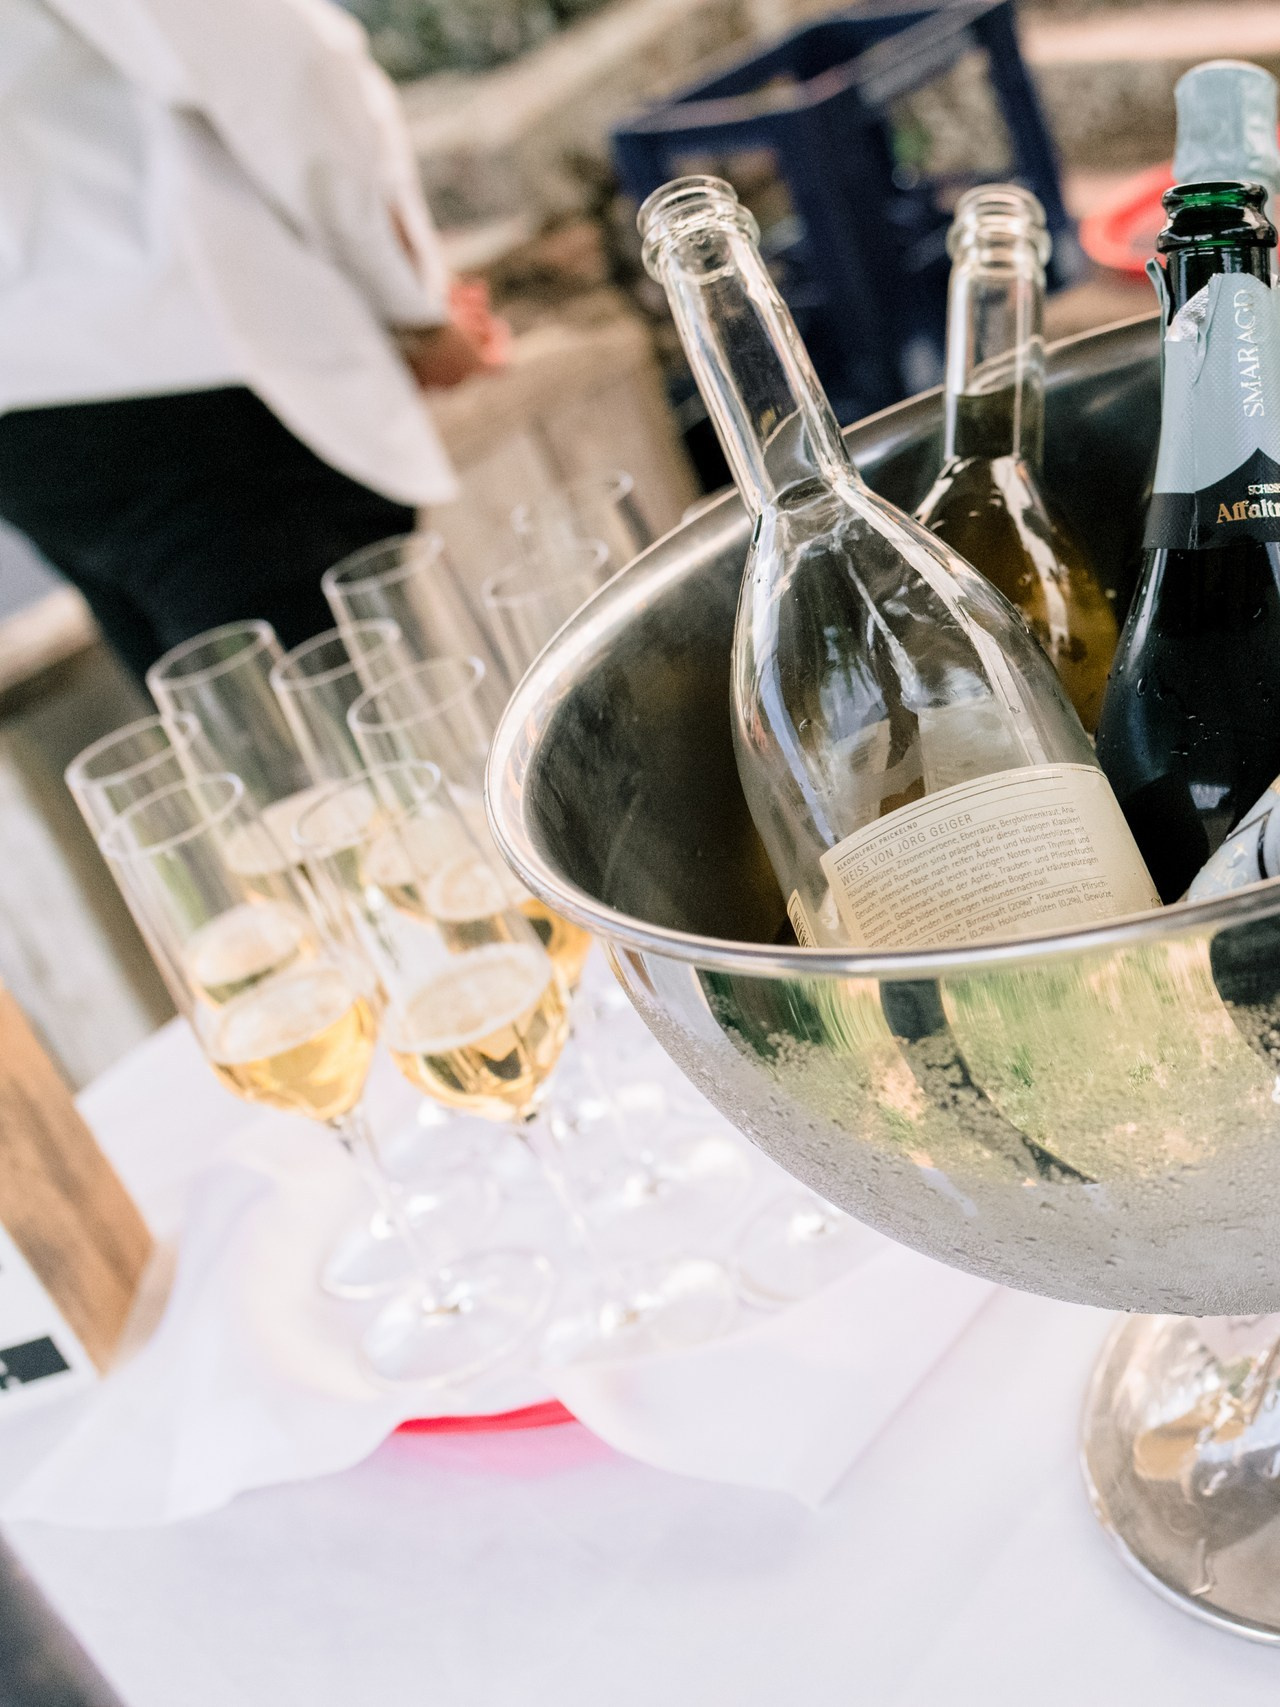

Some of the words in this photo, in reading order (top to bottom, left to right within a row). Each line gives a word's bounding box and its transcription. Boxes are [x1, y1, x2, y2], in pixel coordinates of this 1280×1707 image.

[1234, 289, 1265, 417] SMARAGD
[836, 842, 878, 872] ALKOHOLFREI
[879, 821, 918, 845] PRICKELND
[841, 861, 870, 887] WEISS
[870, 847, 895, 867] VON
[898, 832, 926, 854] JÖRG
[929, 813, 973, 838] GEIGER
[880, 879, 893, 892] und
[893, 862, 929, 883] Rosmarin
[930, 852, 947, 866] sind
[948, 840, 981, 859] prägend
[982, 835, 994, 845] für
[996, 828, 1020, 840] diesen
[1022, 821, 1050, 834] üppigen
[896, 838, 960, 870] Zitronenverbene,
[960, 823, 1000, 841] Eberraute,
[900, 878, 945, 905] Hintergrund
[946, 868, 968, 882] leicht
[969, 856, 1005, 873] würzigen
[1007, 848, 1031, 860] Noten
[1032, 844, 1047, 853] von
[1047, 838, 1077, 850] Thymian
[1078, 836, 1090, 845] und
[937, 888, 954, 898] Von
[955, 881, 968, 892] der
[998, 861, 1033, 874] Trauben-
[1035, 854, 1049, 864] und
[1050, 846, 1095, 860] Pfirsichfrucht
[855, 902, 879, 920] Geruch:
[879, 884, 910, 904] Intensive
[911, 874, 929, 887] Nase
[930, 863, 951, 877] nach
[952, 854, 974, 868] reifen
[976, 843, 1001, 859] Äpfeln
[1003, 839, 1018, 850] und
[915, 907, 939, 923] bilden
[939, 897, 960, 911] einen
[960, 879, 1008, 902] spannenden
[1008, 870, 1033, 884] Bogen
[1034, 867, 1045, 876] zur
[904, 929, 919, 941] und
[919, 918, 942, 934] enden
[943, 912, 954, 921] im
[953, 900, 981, 916] langen
[965, 906, 1007, 929] Birnensaft
[998, 901, 1057, 927] Holunderblüten
